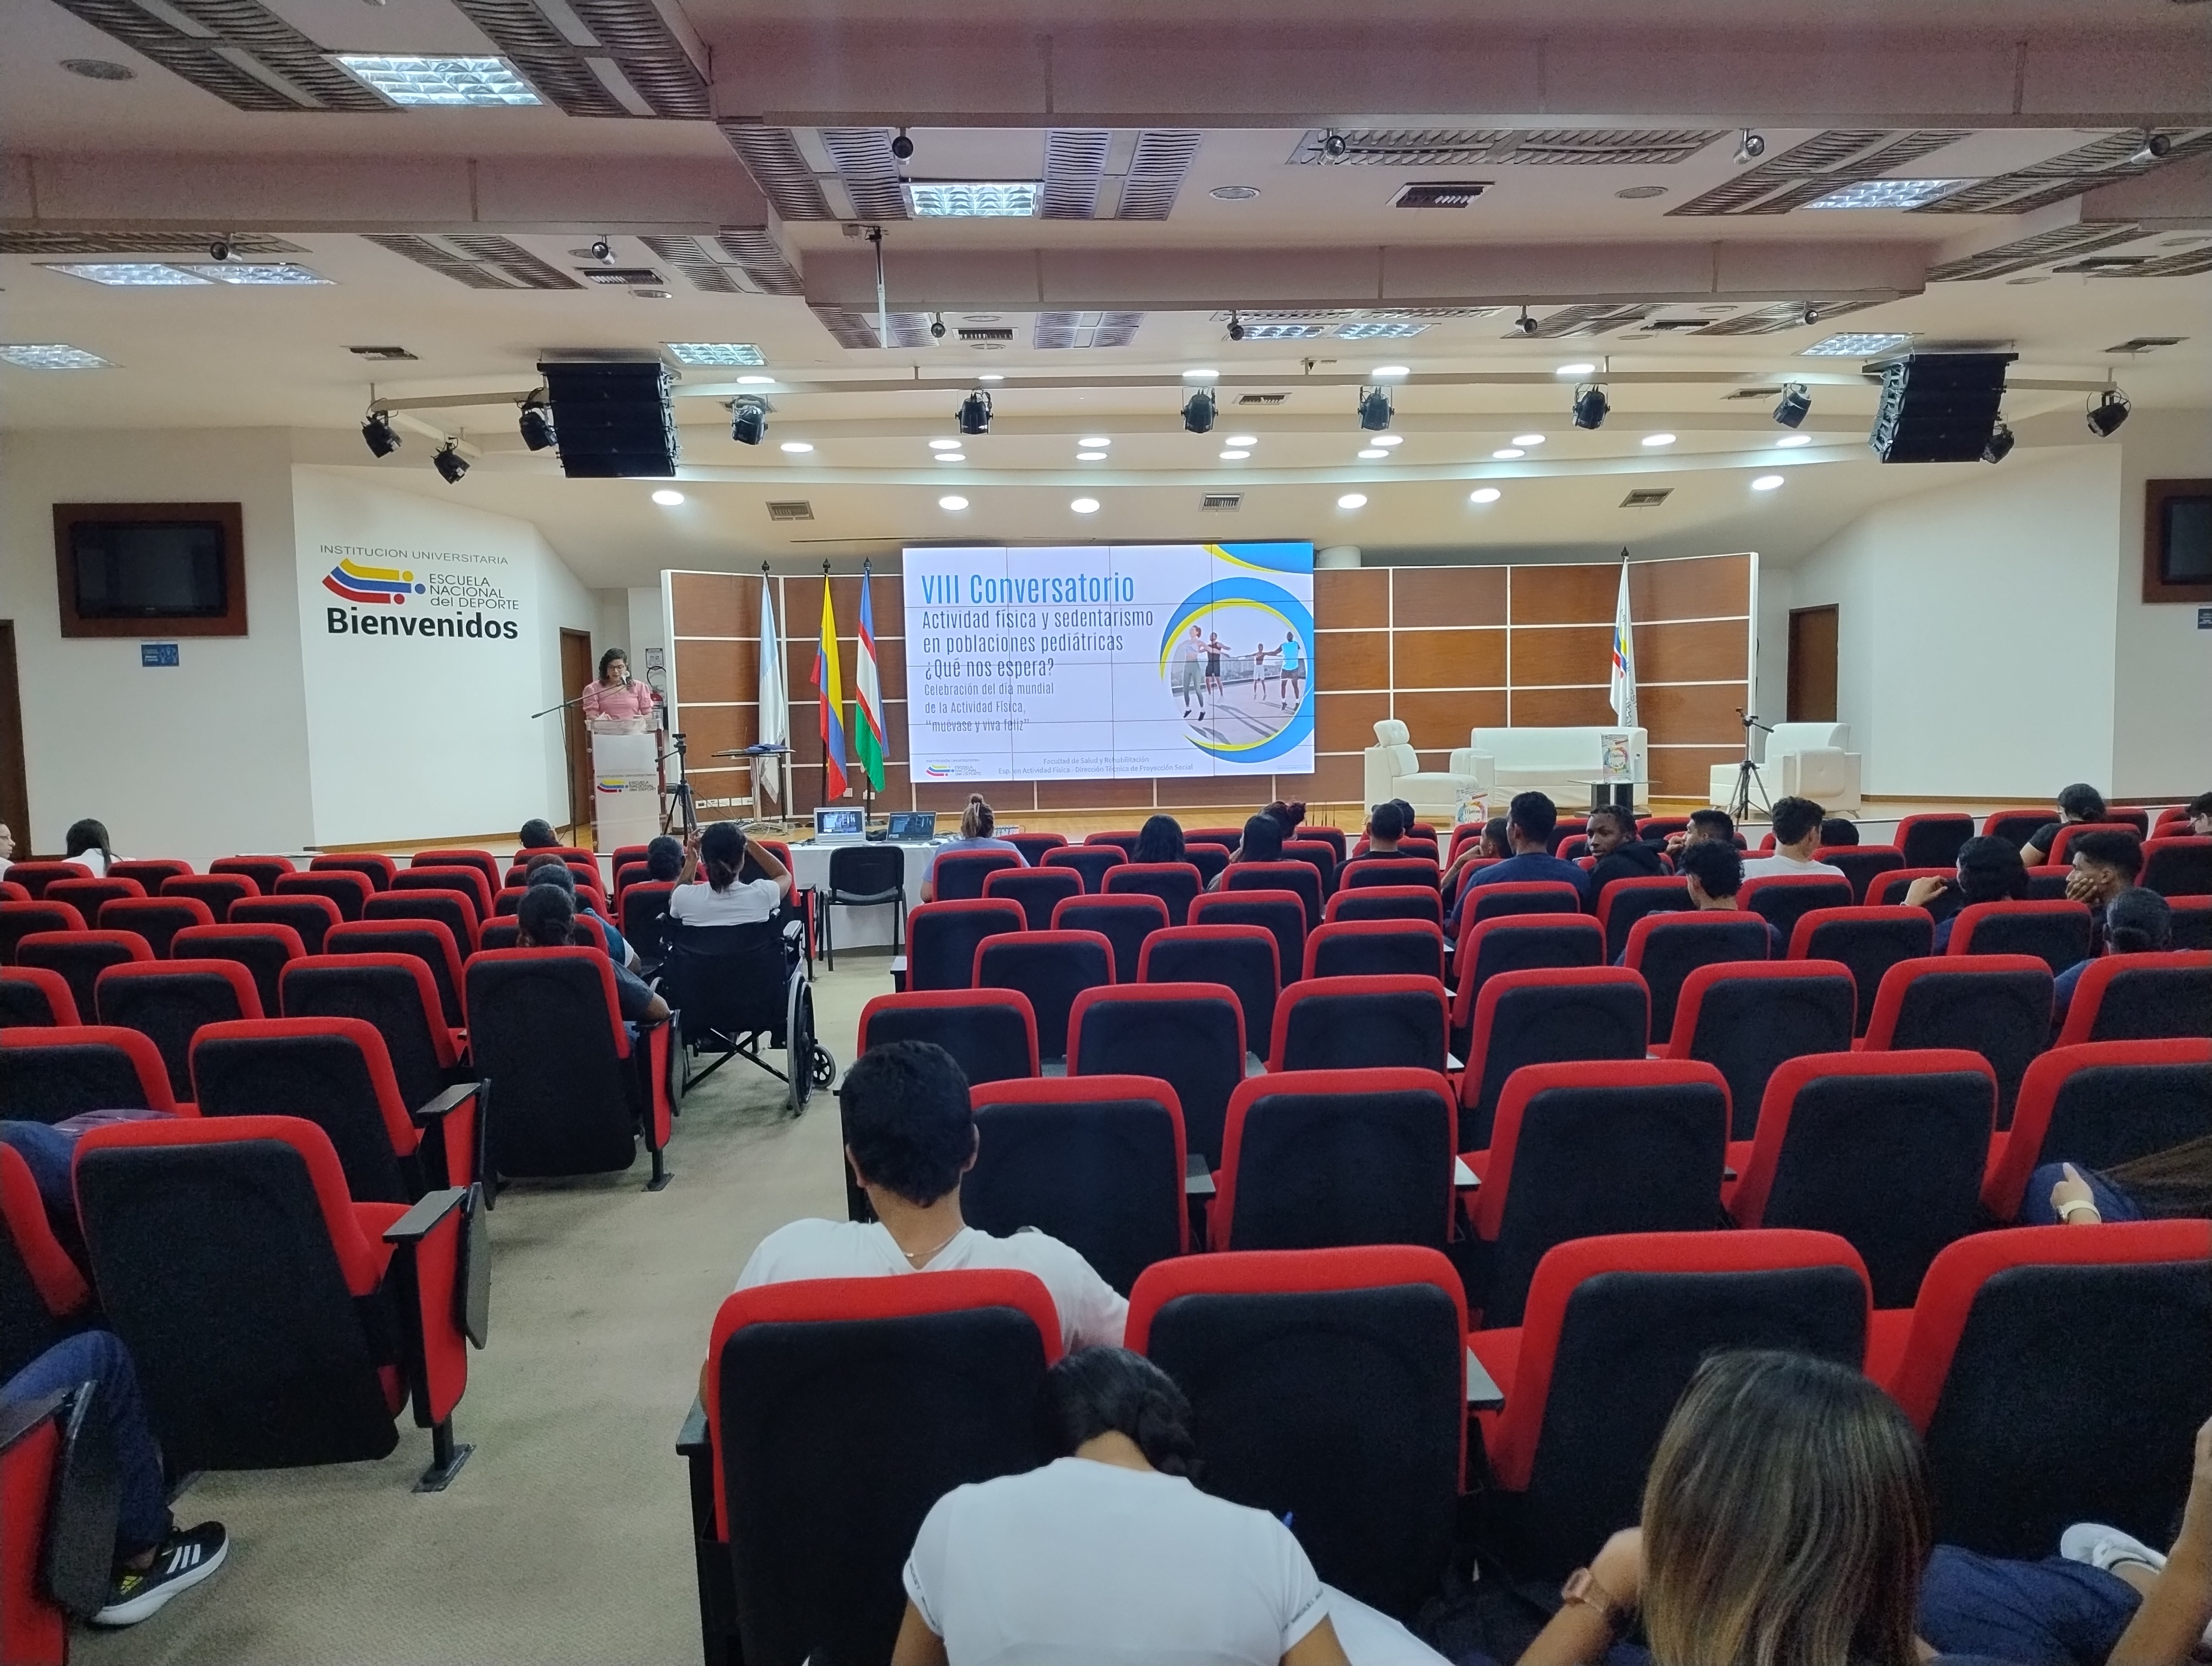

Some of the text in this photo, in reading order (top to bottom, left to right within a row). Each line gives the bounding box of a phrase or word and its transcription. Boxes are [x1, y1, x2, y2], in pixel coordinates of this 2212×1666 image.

[320, 545, 509, 565] INSTITUCION UNIVERSITARIA
[429, 573, 490, 587] ESCUELA
[430, 585, 505, 599] NACIONAL
[921, 571, 1134, 604] VIII Conversatorio
[430, 597, 519, 610] del DEPORTE
[327, 606, 519, 639] Bienvenidos
[923, 608, 1153, 630] Actividad física y sedentarismo
[923, 632, 1124, 656] en poblaciones pediátricas
[925, 657, 1054, 680] ¿Qué nos espera?
[924, 682, 1054, 696] Celebración del día mundial
[925, 701, 1026, 714] de la Actividad Física,
[975, 721, 980, 733] y
[983, 719, 1000, 731] viva
[1104, 755, 1149, 764] Rehabilitación
[1140, 764, 1173, 773] Proyección
